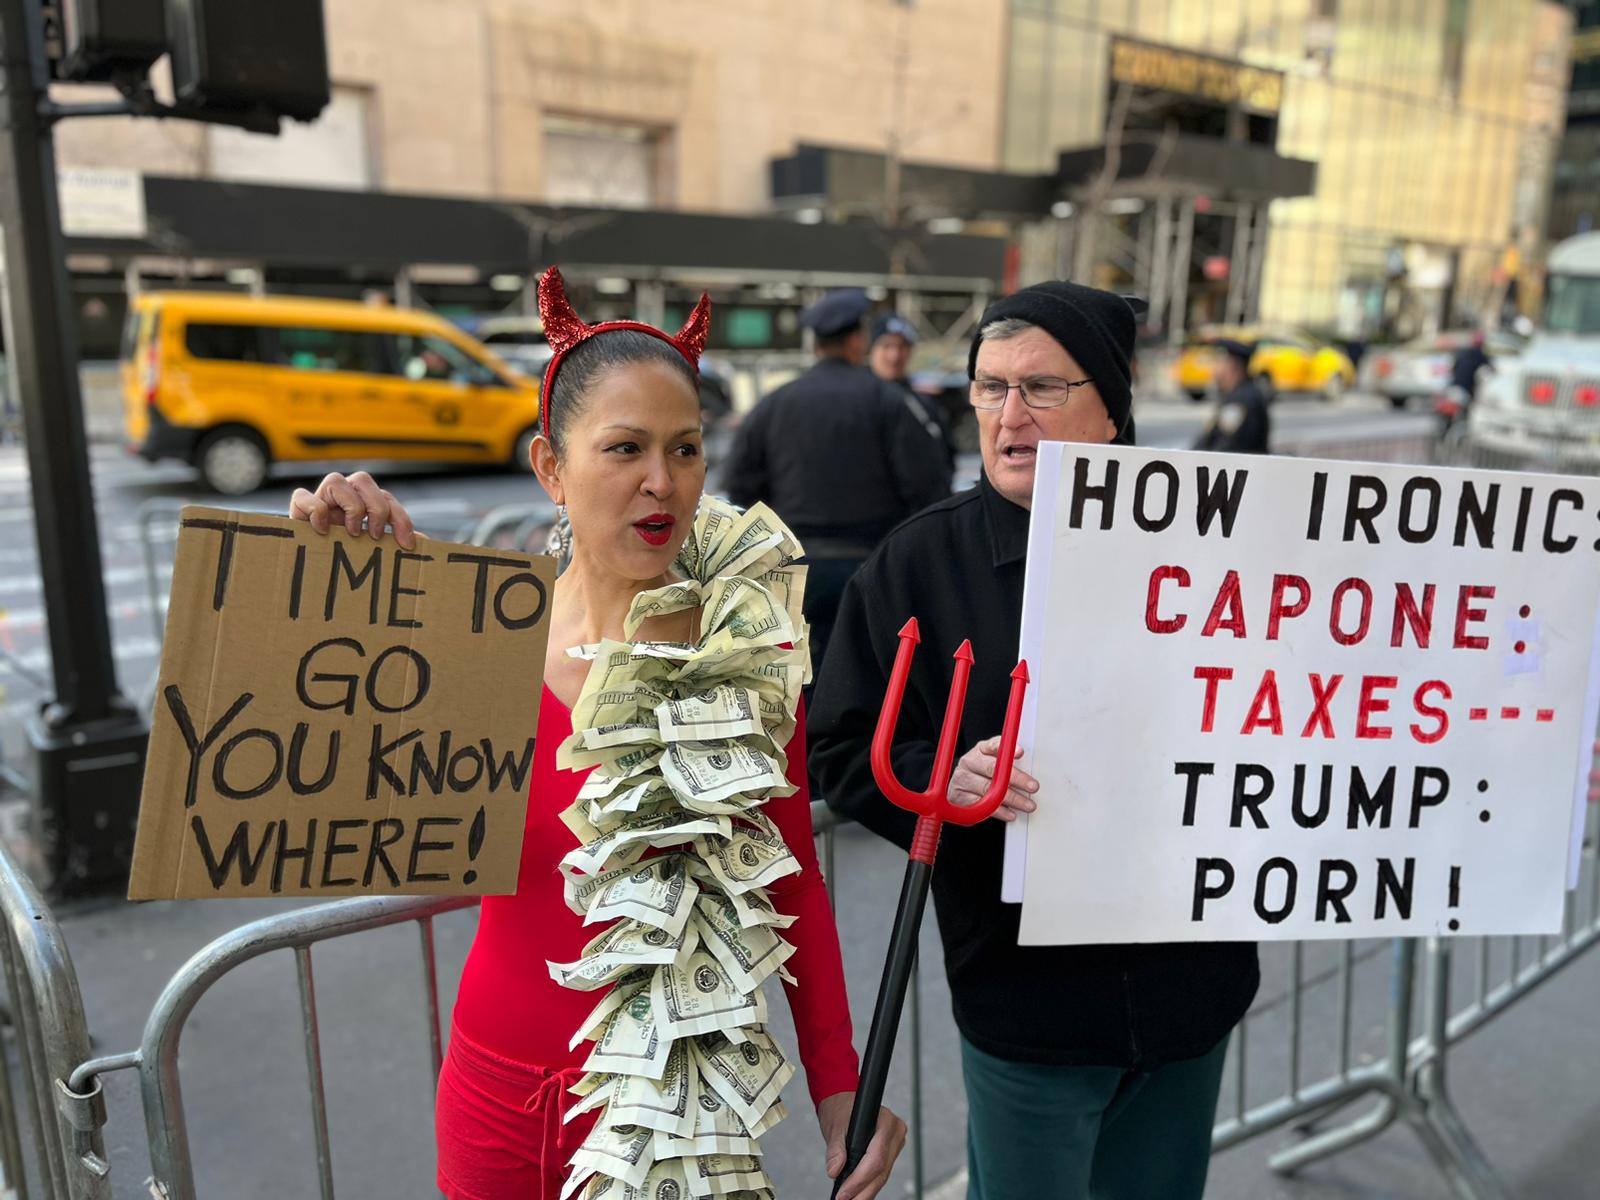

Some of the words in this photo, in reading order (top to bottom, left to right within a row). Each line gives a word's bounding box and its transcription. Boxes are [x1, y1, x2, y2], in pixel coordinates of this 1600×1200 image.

[1068, 456, 1249, 539] HOW
[182, 518, 435, 629] TIME
[447, 552, 548, 634] TO
[1145, 565, 1531, 654] CAPONE:
[295, 636, 431, 716] GO
[163, 684, 341, 809] YOU
[365, 723, 536, 801] KNOW
[190, 804, 486, 894] WHERE!
[1191, 856, 1461, 931] PORN!
